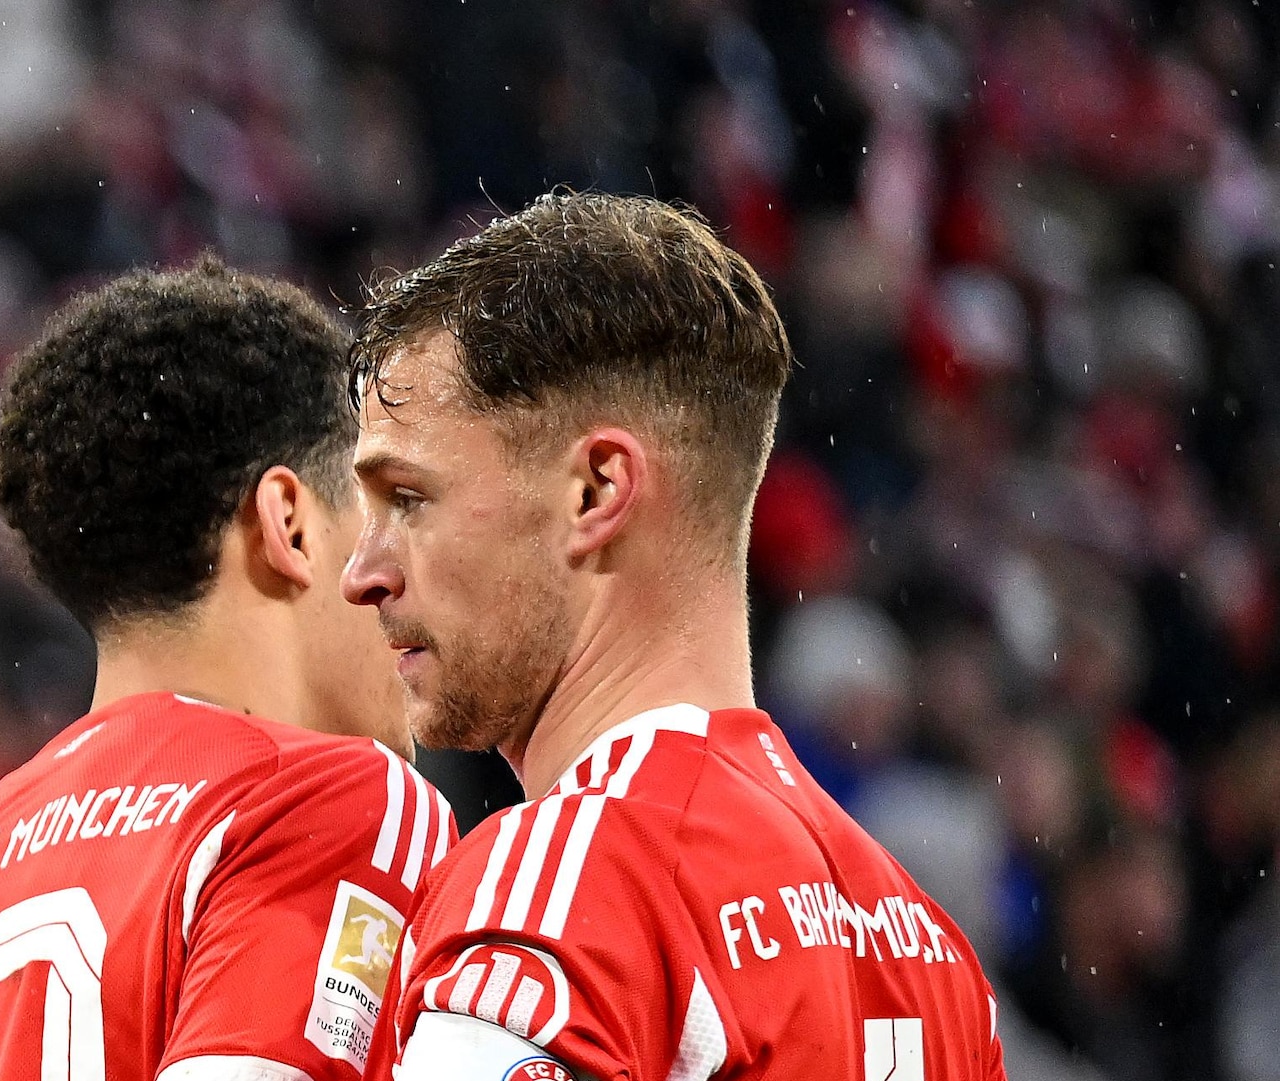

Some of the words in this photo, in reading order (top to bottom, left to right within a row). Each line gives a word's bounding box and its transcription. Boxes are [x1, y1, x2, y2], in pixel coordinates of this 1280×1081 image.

[0, 780, 208, 870] MÜNCHEN
[718, 895, 781, 970] FC
[523, 1062, 550, 1080] FC
